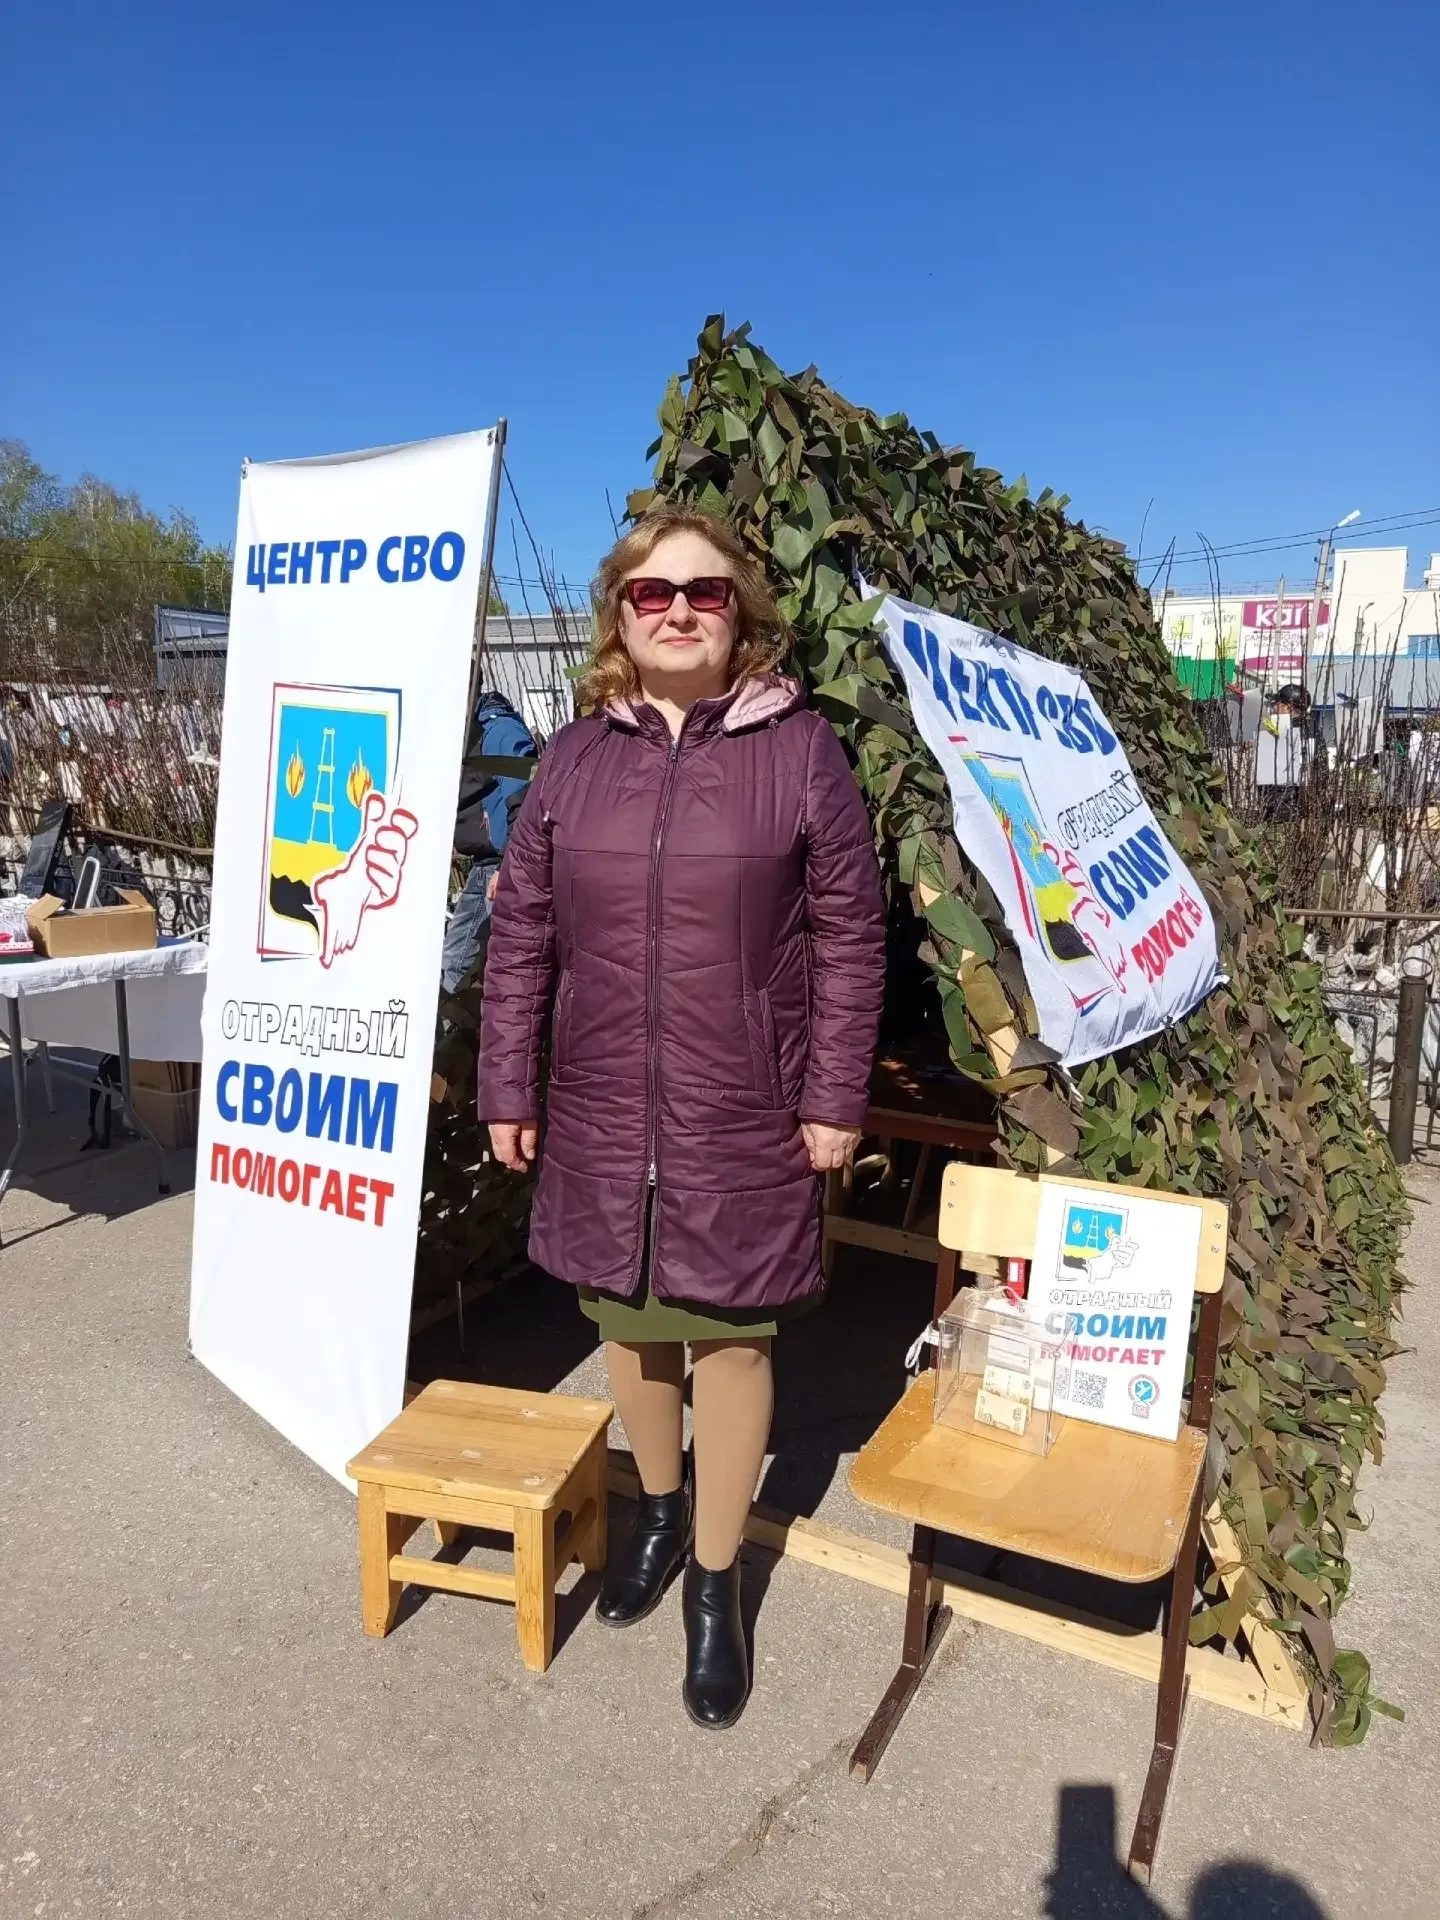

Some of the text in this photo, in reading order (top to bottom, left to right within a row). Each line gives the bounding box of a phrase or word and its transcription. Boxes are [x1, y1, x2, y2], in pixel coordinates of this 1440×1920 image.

[246, 531, 466, 594] ЦЕНТР СВО
[221, 999, 410, 1059] ОТРАДНЫЙ
[216, 1059, 399, 1154] СВОИМ
[209, 1142, 395, 1228] ПОМОГАЕТ
[1044, 1311, 1168, 1341] СВОИМ
[1049, 1288, 1173, 1311] ОТРАДНЫЙ
